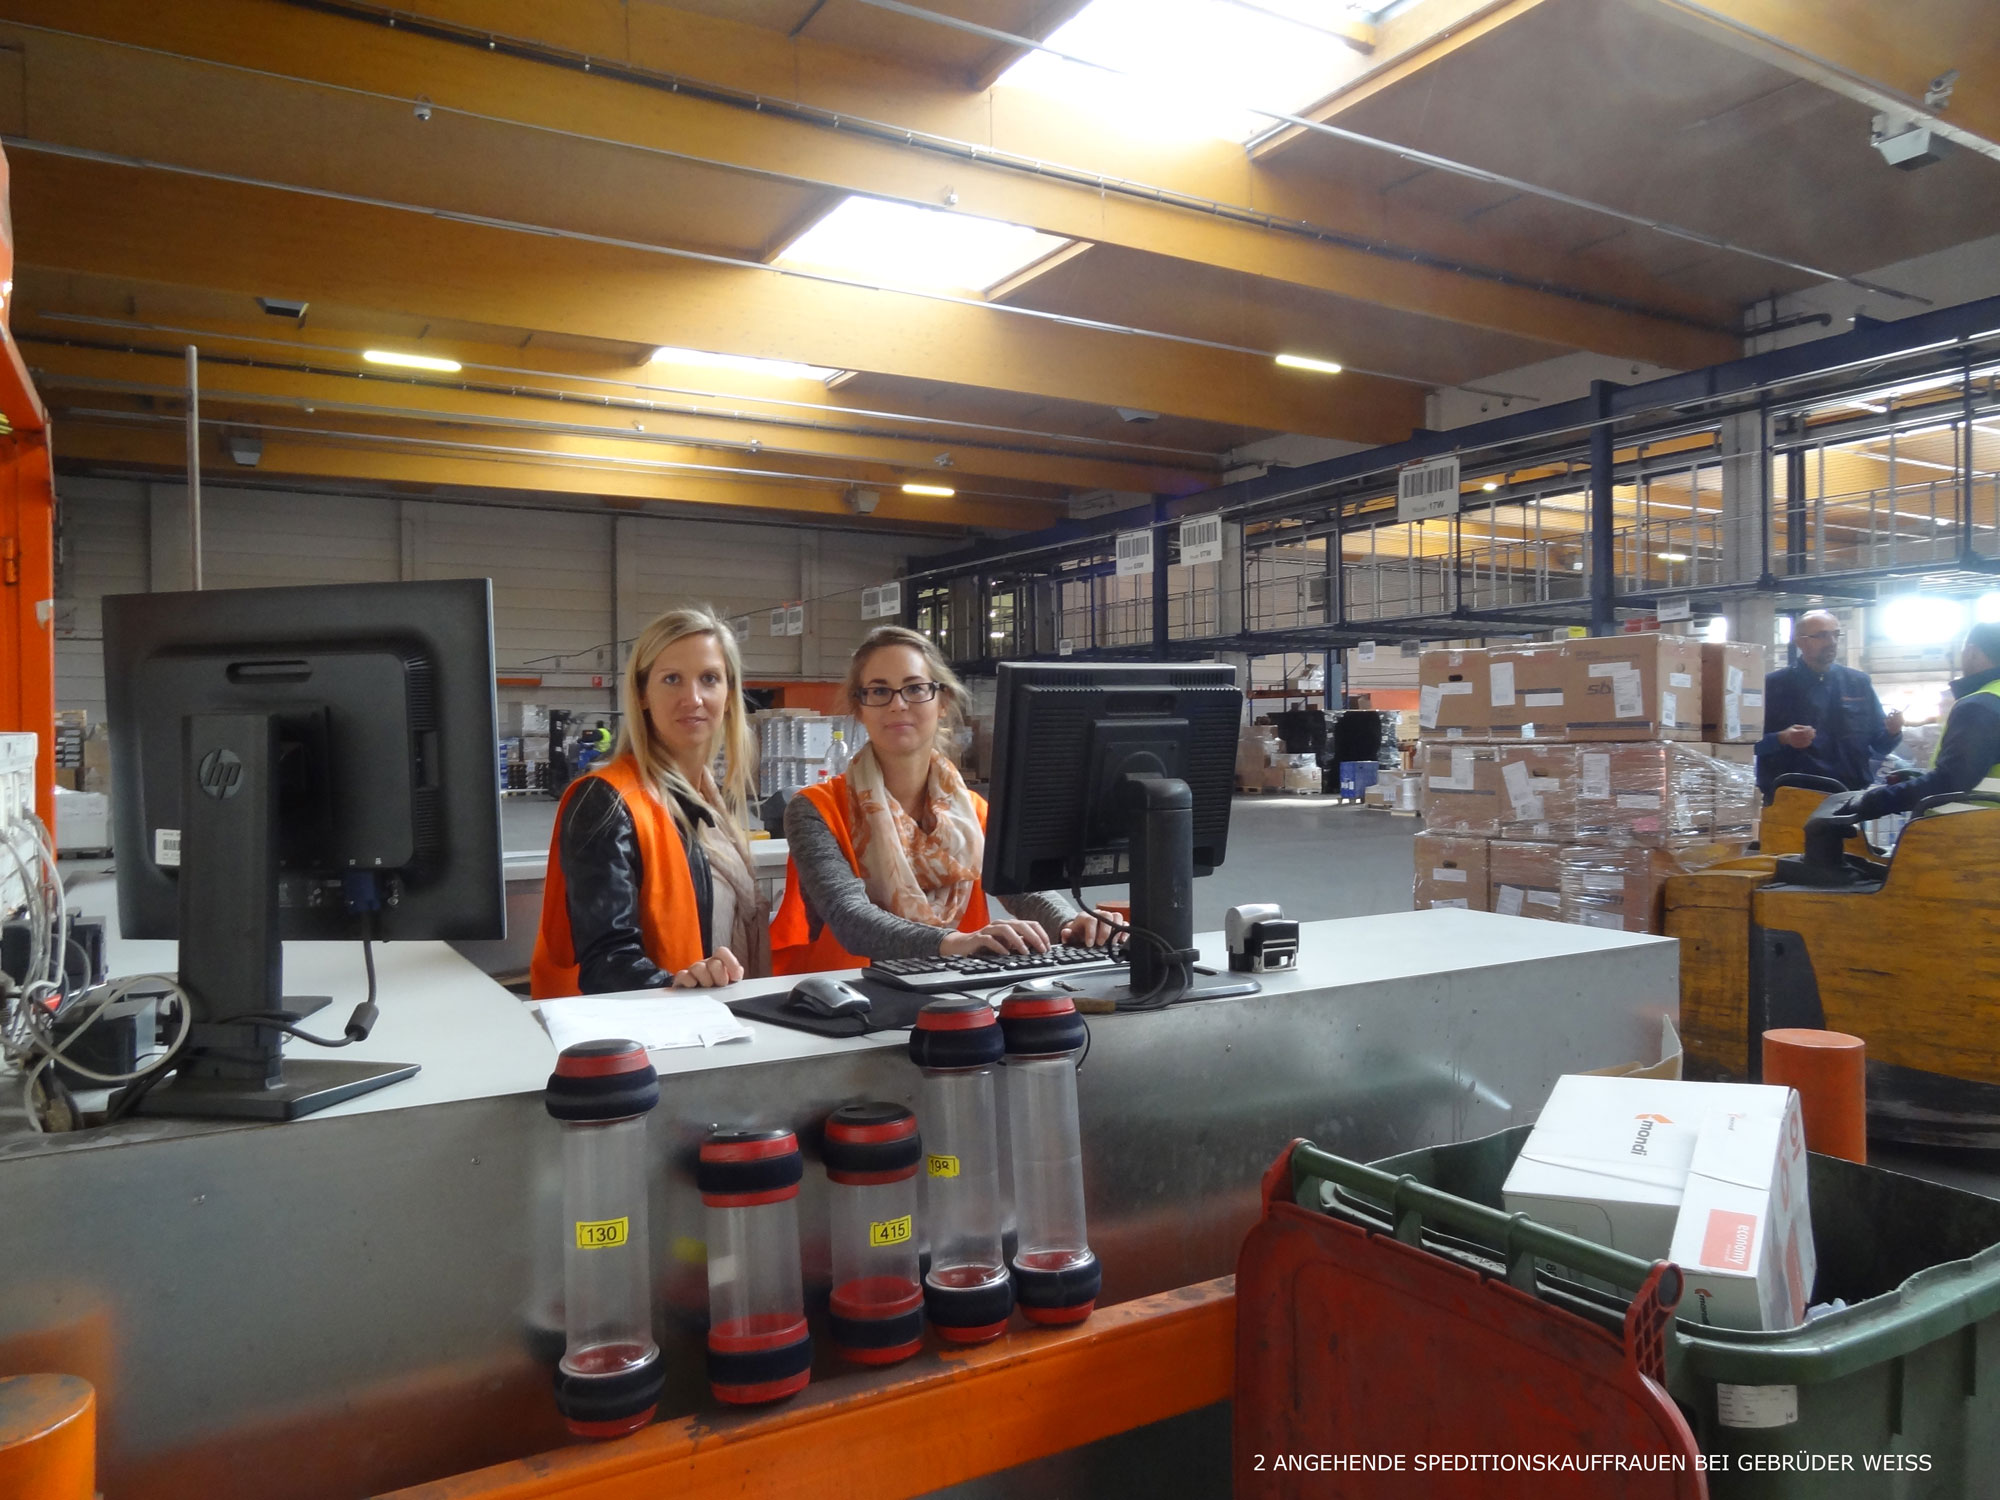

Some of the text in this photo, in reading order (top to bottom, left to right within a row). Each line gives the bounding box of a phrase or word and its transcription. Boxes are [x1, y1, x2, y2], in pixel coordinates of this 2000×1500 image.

[205, 748, 242, 799] hp
[1631, 1119, 1654, 1156] mondi
[587, 1226, 617, 1243] 130
[880, 1222, 905, 1240] 415
[1728, 1223, 1751, 1265] economy
